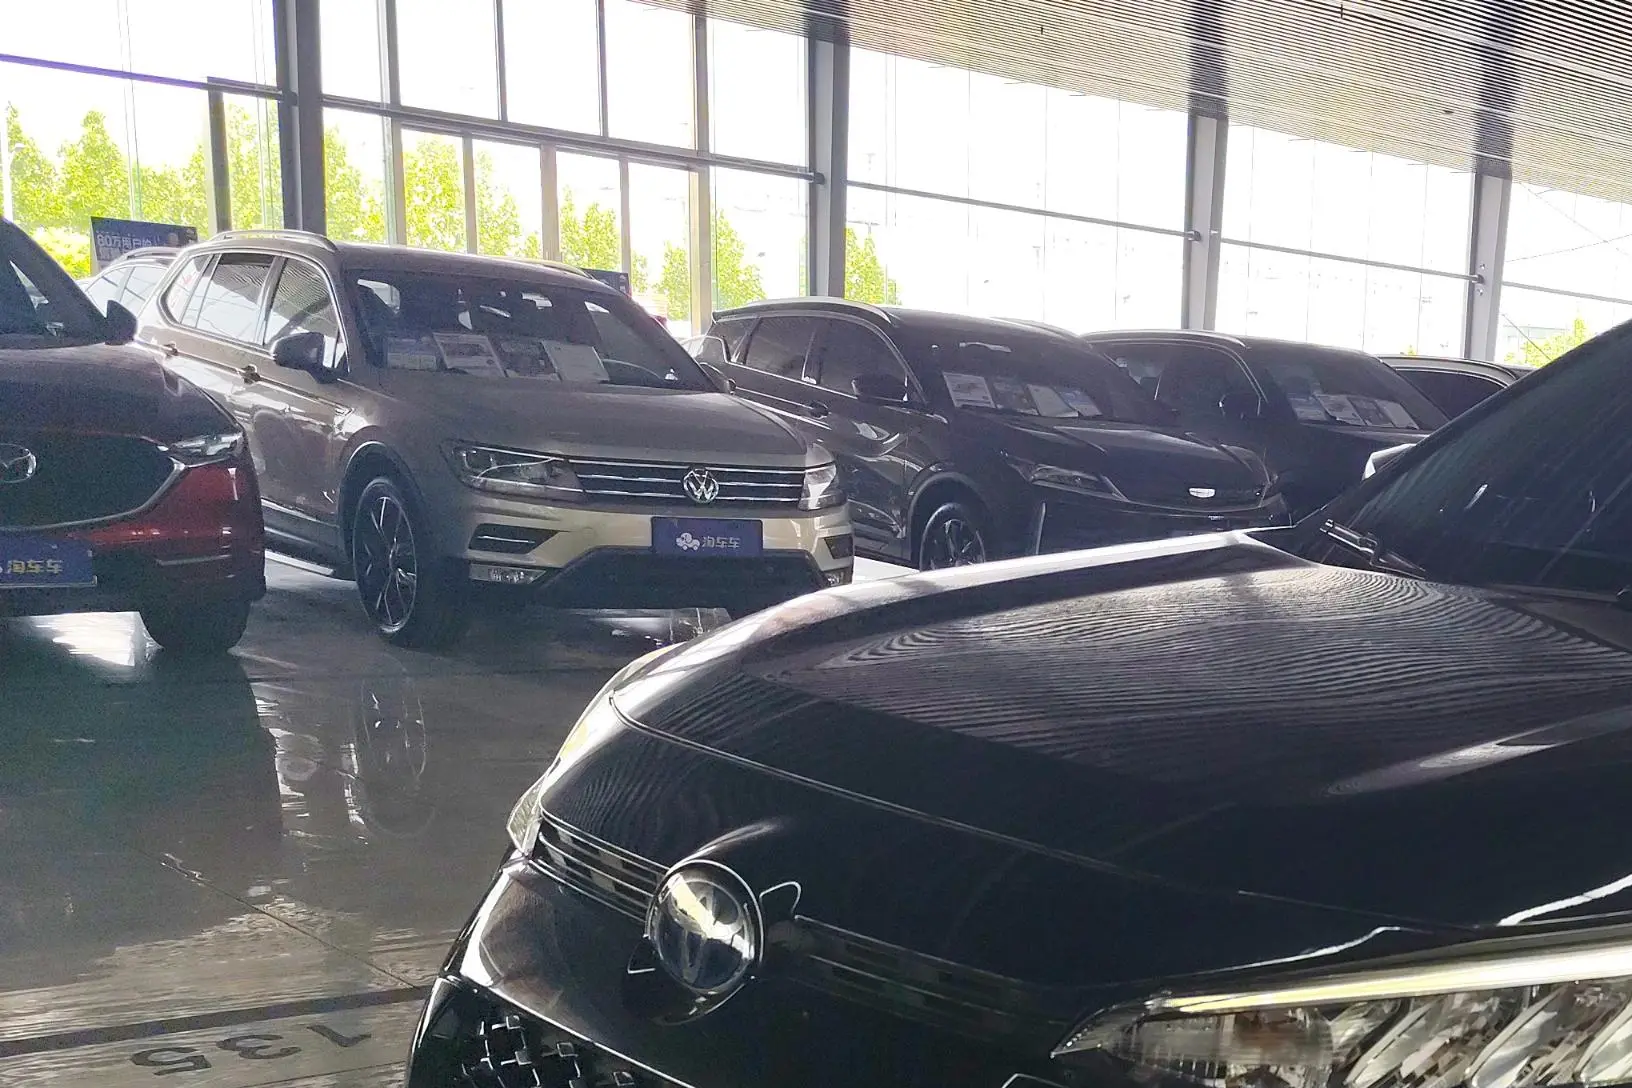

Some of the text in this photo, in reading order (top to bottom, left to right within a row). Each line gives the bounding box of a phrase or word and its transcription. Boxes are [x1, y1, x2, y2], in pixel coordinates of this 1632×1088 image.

[701, 536, 741, 549] 淘车车
[7, 559, 63, 574] 淘车车
[129, 1023, 372, 1076] 135
